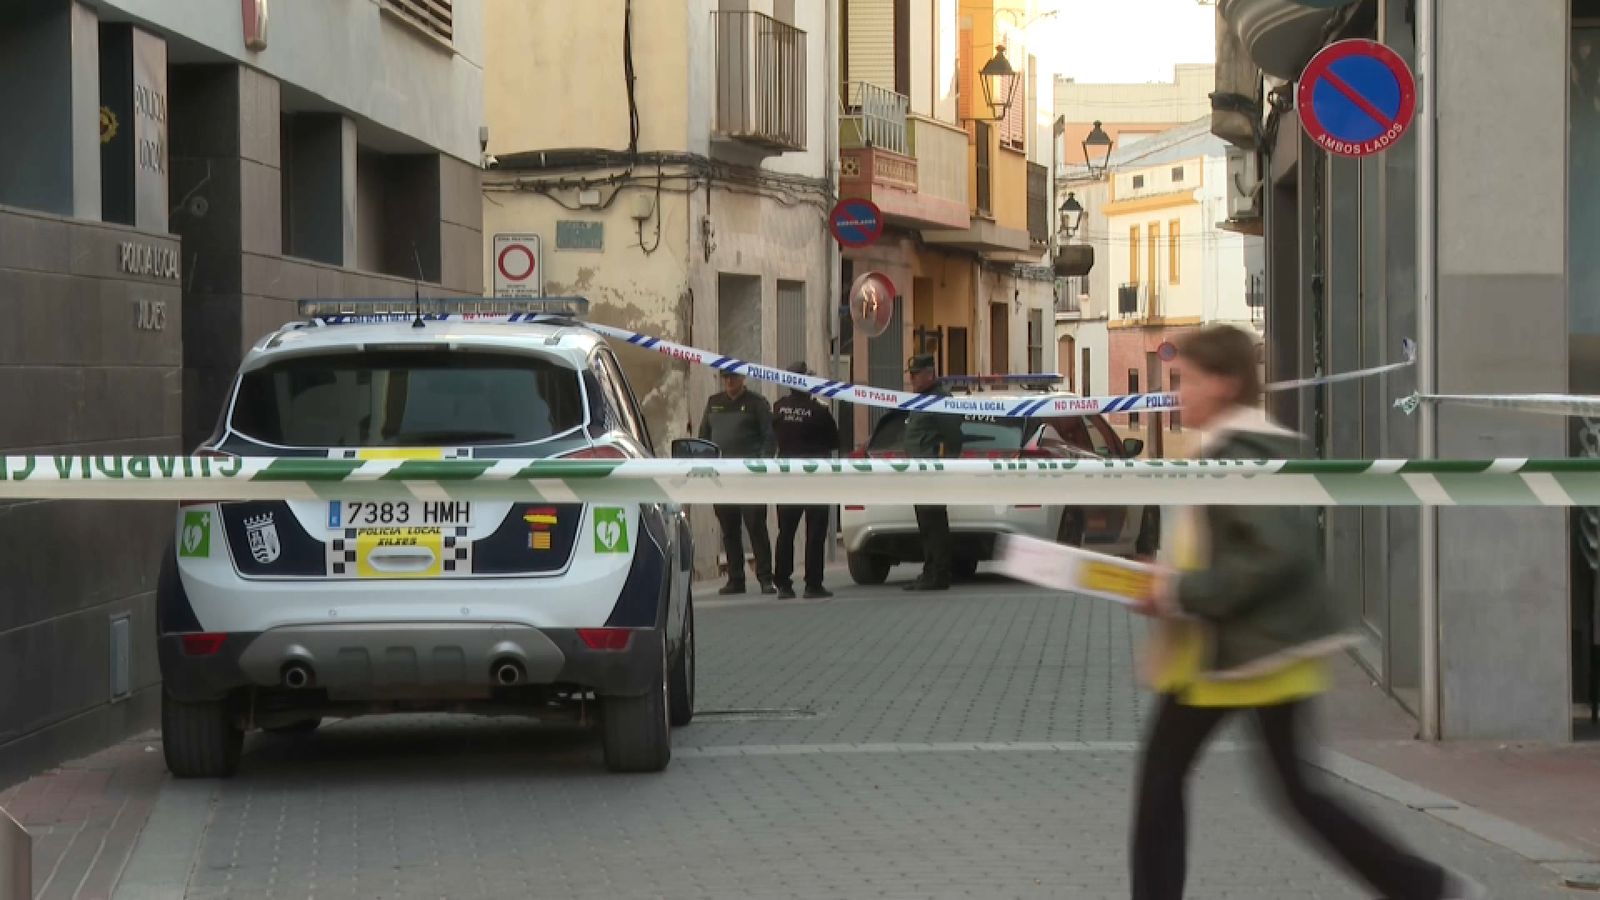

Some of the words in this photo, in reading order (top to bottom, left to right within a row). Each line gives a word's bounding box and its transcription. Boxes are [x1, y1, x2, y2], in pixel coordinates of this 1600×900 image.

[1318, 133, 1360, 154] AMBOS
[1365, 122, 1403, 153] LADOS
[748, 366, 779, 381] POLICIA
[782, 373, 808, 387] LOCAL
[855, 389, 867, 398] NO
[869, 391, 898, 403] PASAR
[945, 400, 977, 410] POLICIA
[980, 401, 1005, 411] LOCAL
[1054, 400, 1067, 411] NO
[1069, 399, 1099, 410] PASAR
[780, 407, 811, 418] POLICIA
[348, 502, 409, 524] 7383
[424, 501, 470, 523] HMH
[357, 527, 401, 536] POLICIA
[408, 526, 441, 535] LOCAL
